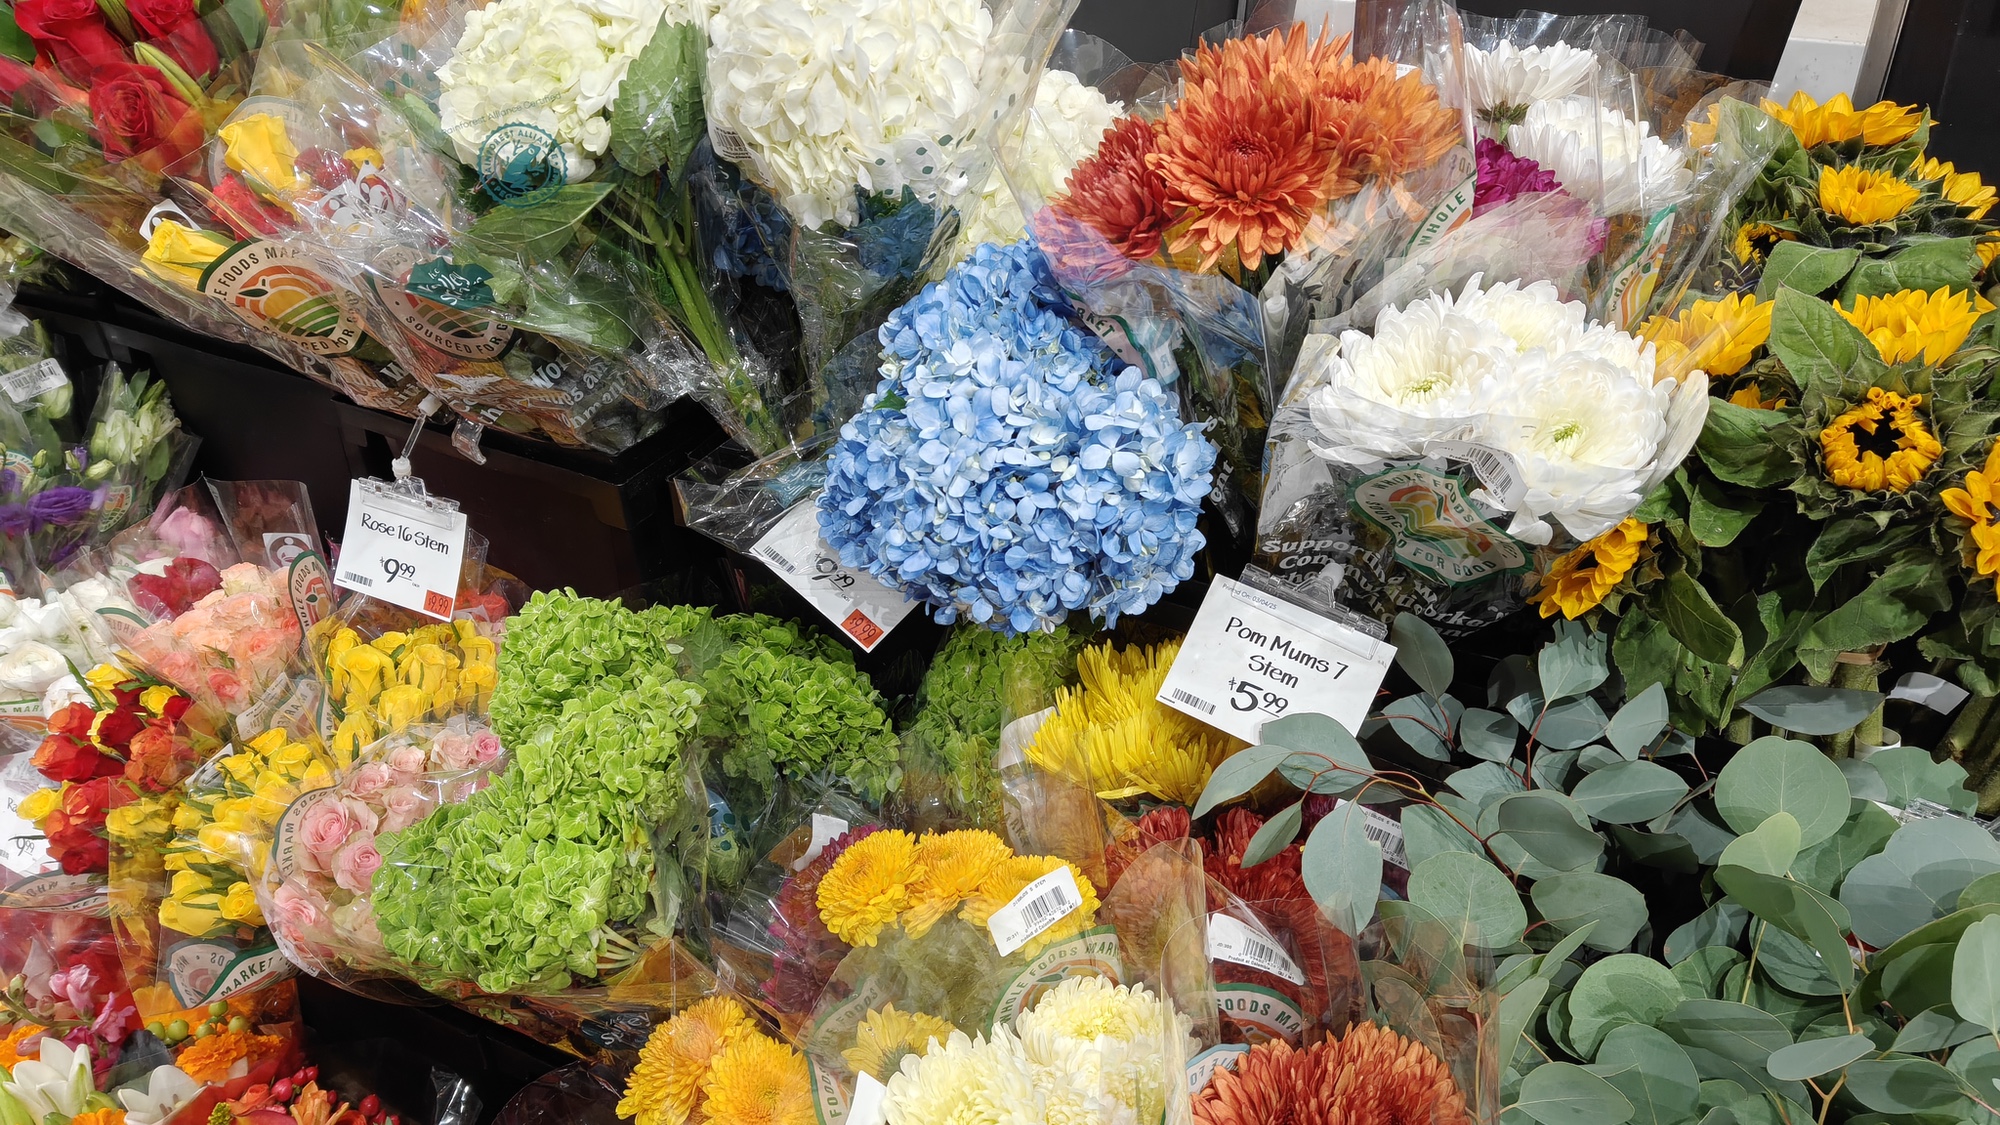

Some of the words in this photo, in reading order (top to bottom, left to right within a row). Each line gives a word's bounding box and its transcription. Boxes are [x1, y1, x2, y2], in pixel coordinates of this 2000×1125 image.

[487, 105, 522, 121] Alliance
[523, 92, 562, 109] Certified
[1418, 191, 1466, 247] WHOLE
[218, 252, 260, 288] FOODS
[405, 315, 473, 354] SOURCED
[476, 336, 503, 355] FOR
[1076, 307, 1115, 338] RKET
[1371, 471, 1425, 490] WHOLE
[1432, 478, 1475, 523] FOODS
[361, 512, 395, 537] Rose
[398, 525, 413, 543] 16
[414, 531, 449, 555] Stem
[295, 565, 311, 594] FOODS
[1412, 547, 1445, 570] FOR
[1452, 560, 1497, 577] GOOD
[428, 595, 450, 613] $9.99
[1251, 595, 1278, 610] 03/04/25
[849, 617, 877, 641] $9.99
[1224, 615, 1268, 648] Pom
[1269, 634, 1330, 675] Mums
[1331, 660, 1350, 680] 7
[1247, 653, 1299, 689] Stem
[220, 957, 274, 996] MARKET
[1228, 955, 1244, 963] Product
[1251, 960, 1271, 970] Colombia
[1000, 981, 1029, 1025] WHOLE
[1029, 946, 1078, 977] FOODS
[836, 987, 878, 1026] FOODS
